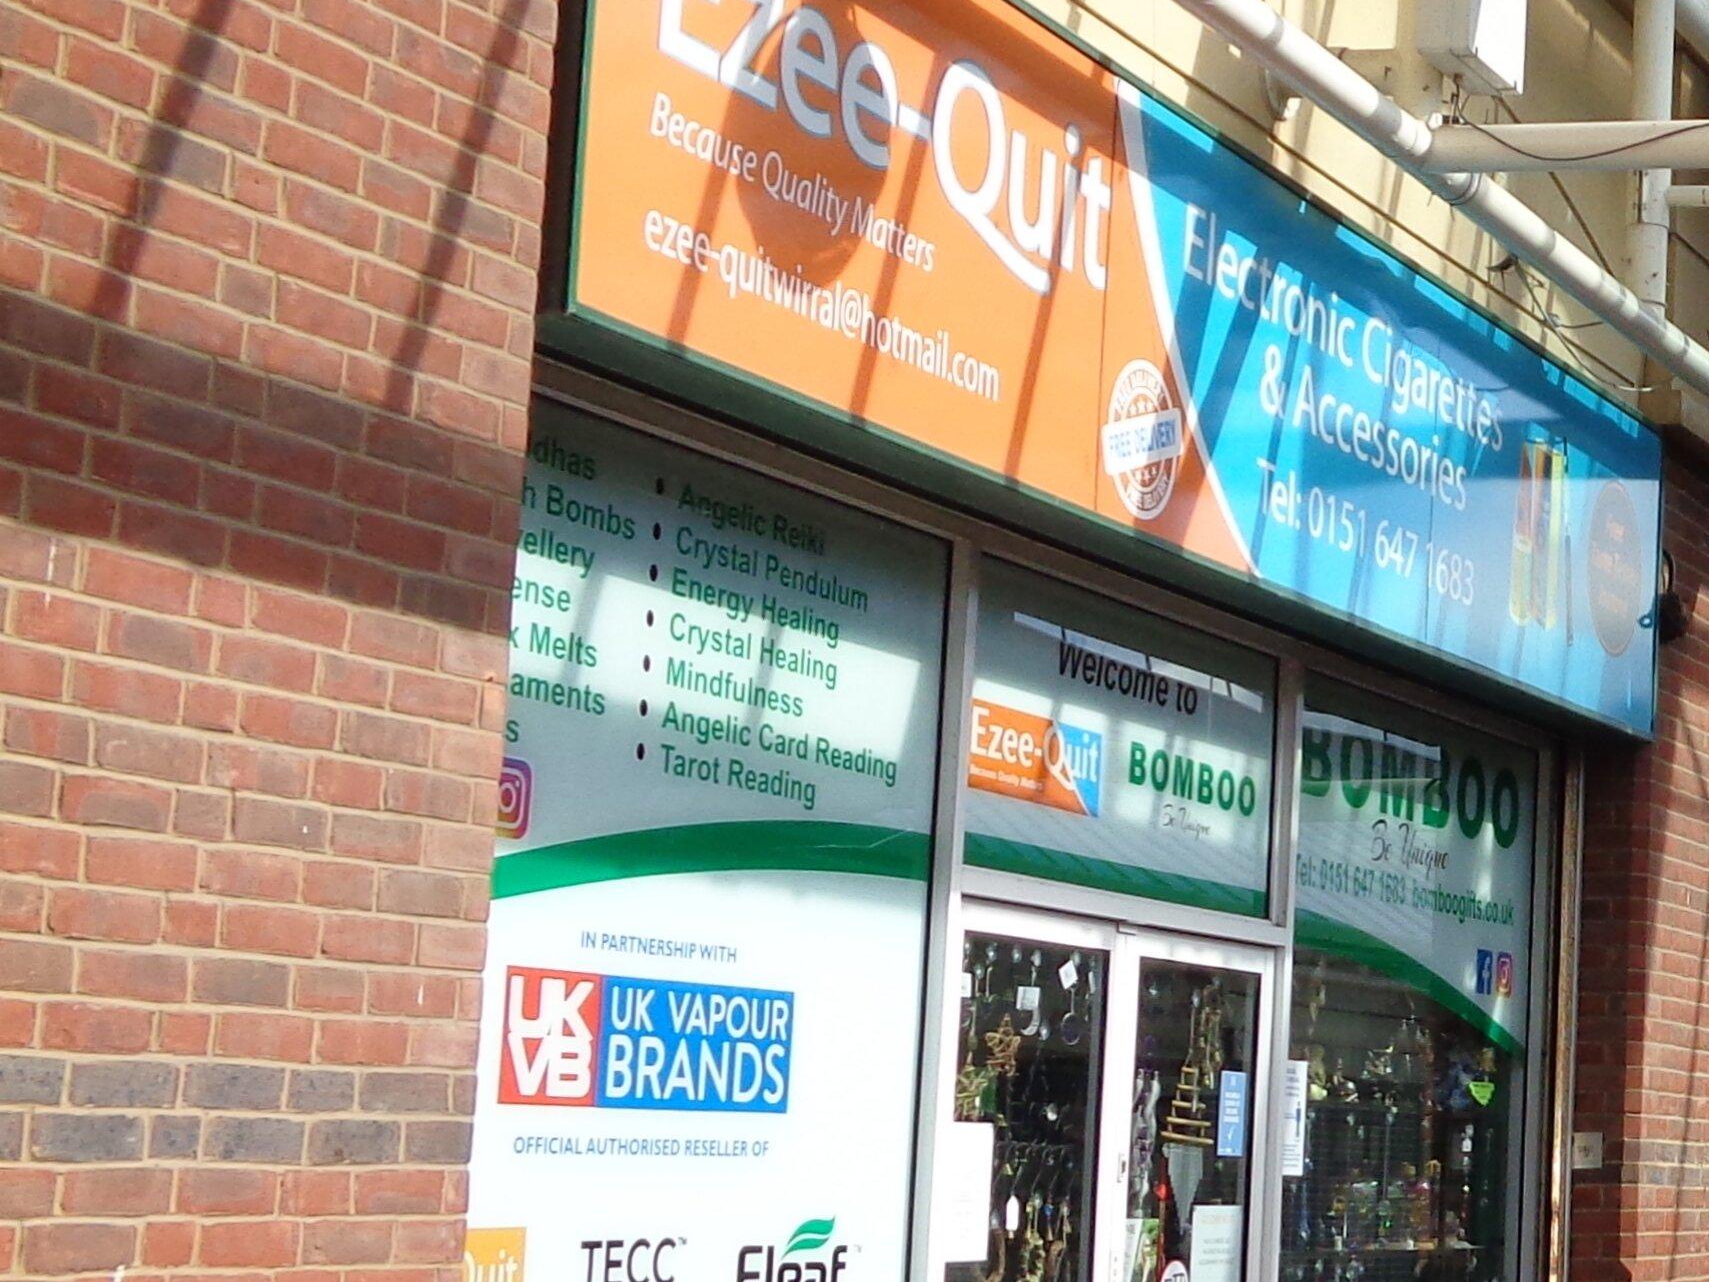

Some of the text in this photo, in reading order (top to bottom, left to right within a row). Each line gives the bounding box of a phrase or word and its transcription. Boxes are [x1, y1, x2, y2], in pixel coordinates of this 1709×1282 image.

[649, 91, 936, 273] Because Quality Matters
[643, 209, 1001, 402] ezee-quitwirral@hotmail.com
[1181, 202, 1503, 452] Electronic Cigarettes
[1258, 343, 1285, 419] &
[1294, 362, 1467, 512] Accessories
[546, 483, 637, 542] Bombs
[677, 483, 826, 558] Angelic Reiki
[1256, 456, 1475, 607] Tel: 0151 647 1683
[671, 565, 841, 648] Energy Healing
[675, 524, 869, 616] Crystal Pendulum
[529, 621, 598, 669] Melts
[668, 611, 839, 691] Crystal Healing
[1058, 640, 1198, 716] Welcome to
[665, 656, 805, 719] Mindfulness
[660, 743, 817, 811] Tarot Reading
[661, 701, 898, 789] Angelic Card Reading
[969, 704, 1099, 792] Ezee-Quit
[1128, 740, 1256, 817] BOMBOO
[1302, 723, 1520, 849] BOMBOO
[580, 930, 738, 964] IN PARTNERSHIP WITH
[611, 985, 790, 1042] UK VAPOUR
[604, 1033, 786, 1106] BRANDS
[513, 1134, 770, 1158] OFFICIAL AUTHORISED RESELLER OF
